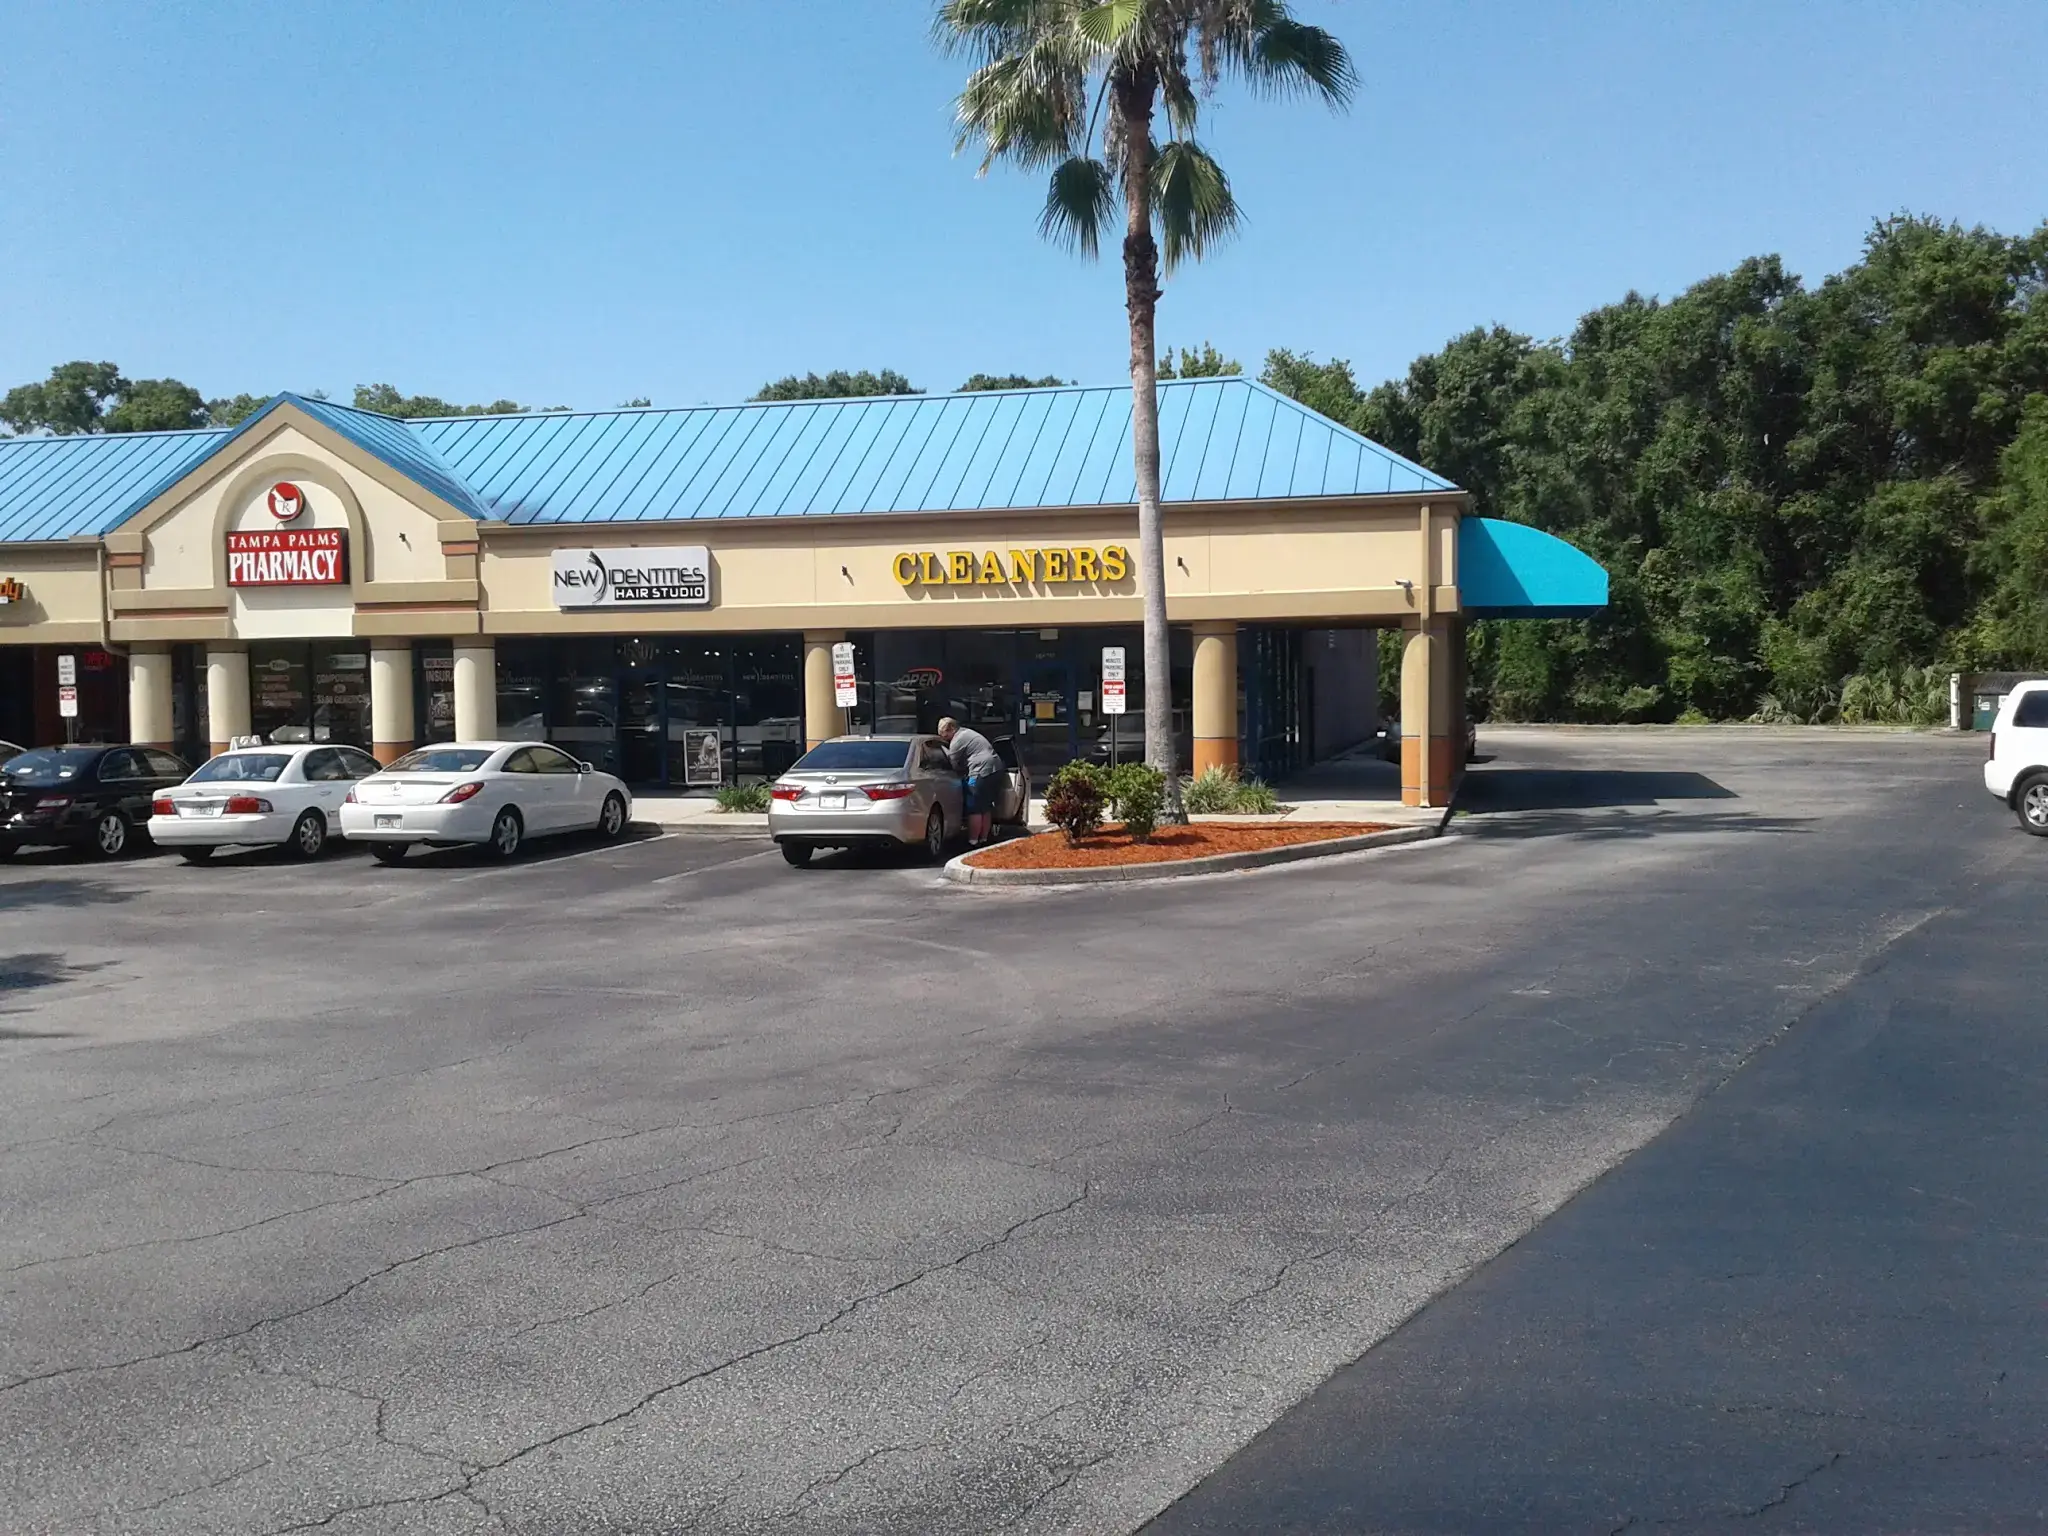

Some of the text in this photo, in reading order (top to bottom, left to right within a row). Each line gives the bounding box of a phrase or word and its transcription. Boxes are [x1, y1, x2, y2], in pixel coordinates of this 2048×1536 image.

[228, 532, 339, 549] TAMPA PALMS
[228, 549, 339, 583] PHARMACY
[892, 545, 1127, 586] CLEANERS
[554, 567, 706, 588] NEW IDENTITIES
[615, 587, 704, 599] HAIR STUDIO
[901, 672, 938, 687] OPEN
